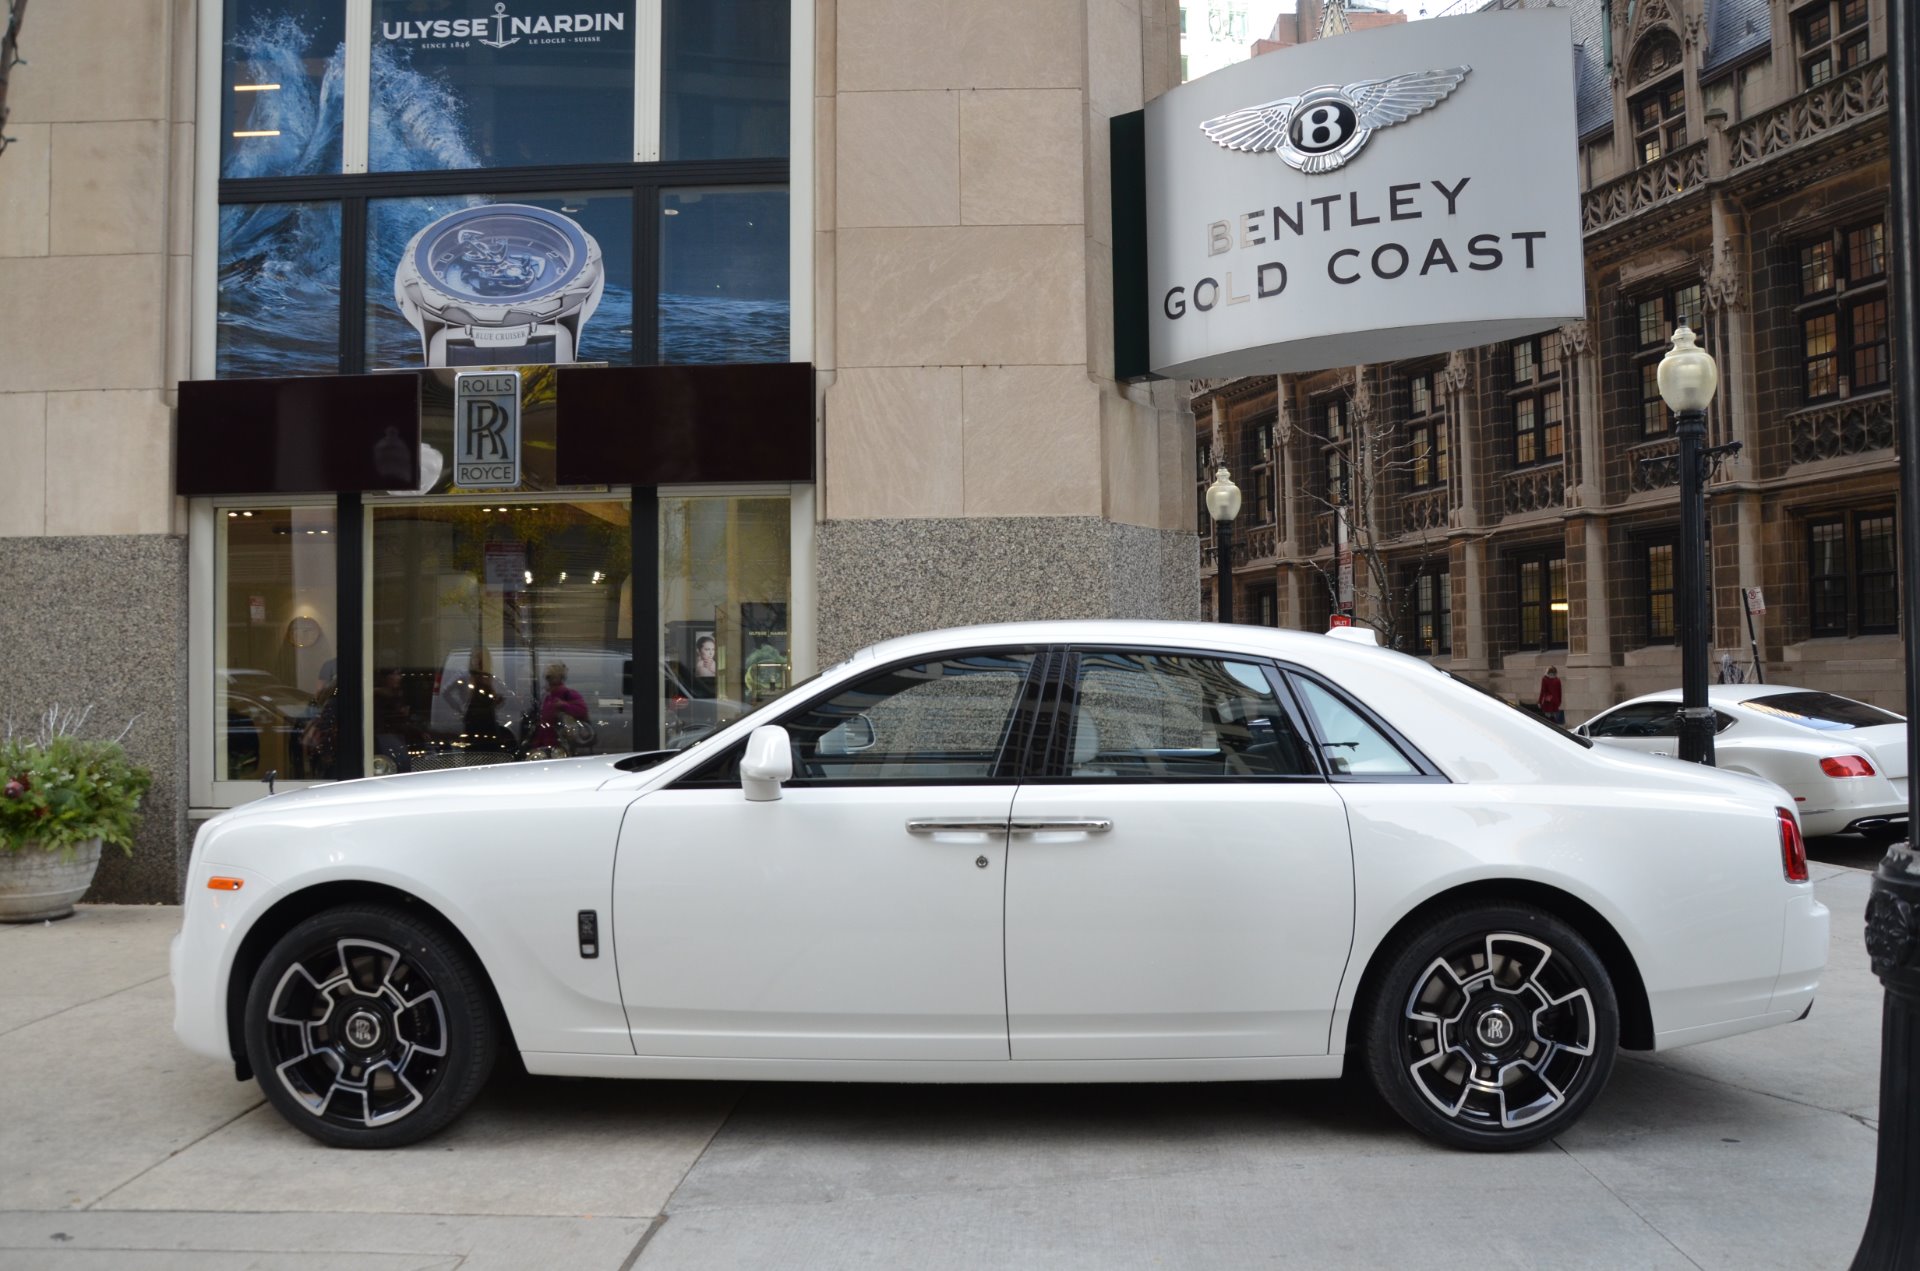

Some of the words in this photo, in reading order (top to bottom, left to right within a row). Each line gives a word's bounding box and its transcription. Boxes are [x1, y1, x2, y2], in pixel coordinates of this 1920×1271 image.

[383, 18, 488, 40] ULYSSE
[511, 12, 625, 35] NARDIN
[450, 40, 471, 49] 1846
[541, 37, 566, 45] LOCLE
[1301, 104, 1342, 149] B
[1207, 177, 1471, 257] BENTLEY
[1164, 261, 1288, 321] GOLD
[1327, 231, 1547, 285] COAST
[475, 331, 494, 341] BLUE
[495, 330, 527, 341] CRUISER
[462, 379, 512, 393] ROLLS
[461, 466, 512, 480] ROYCE
